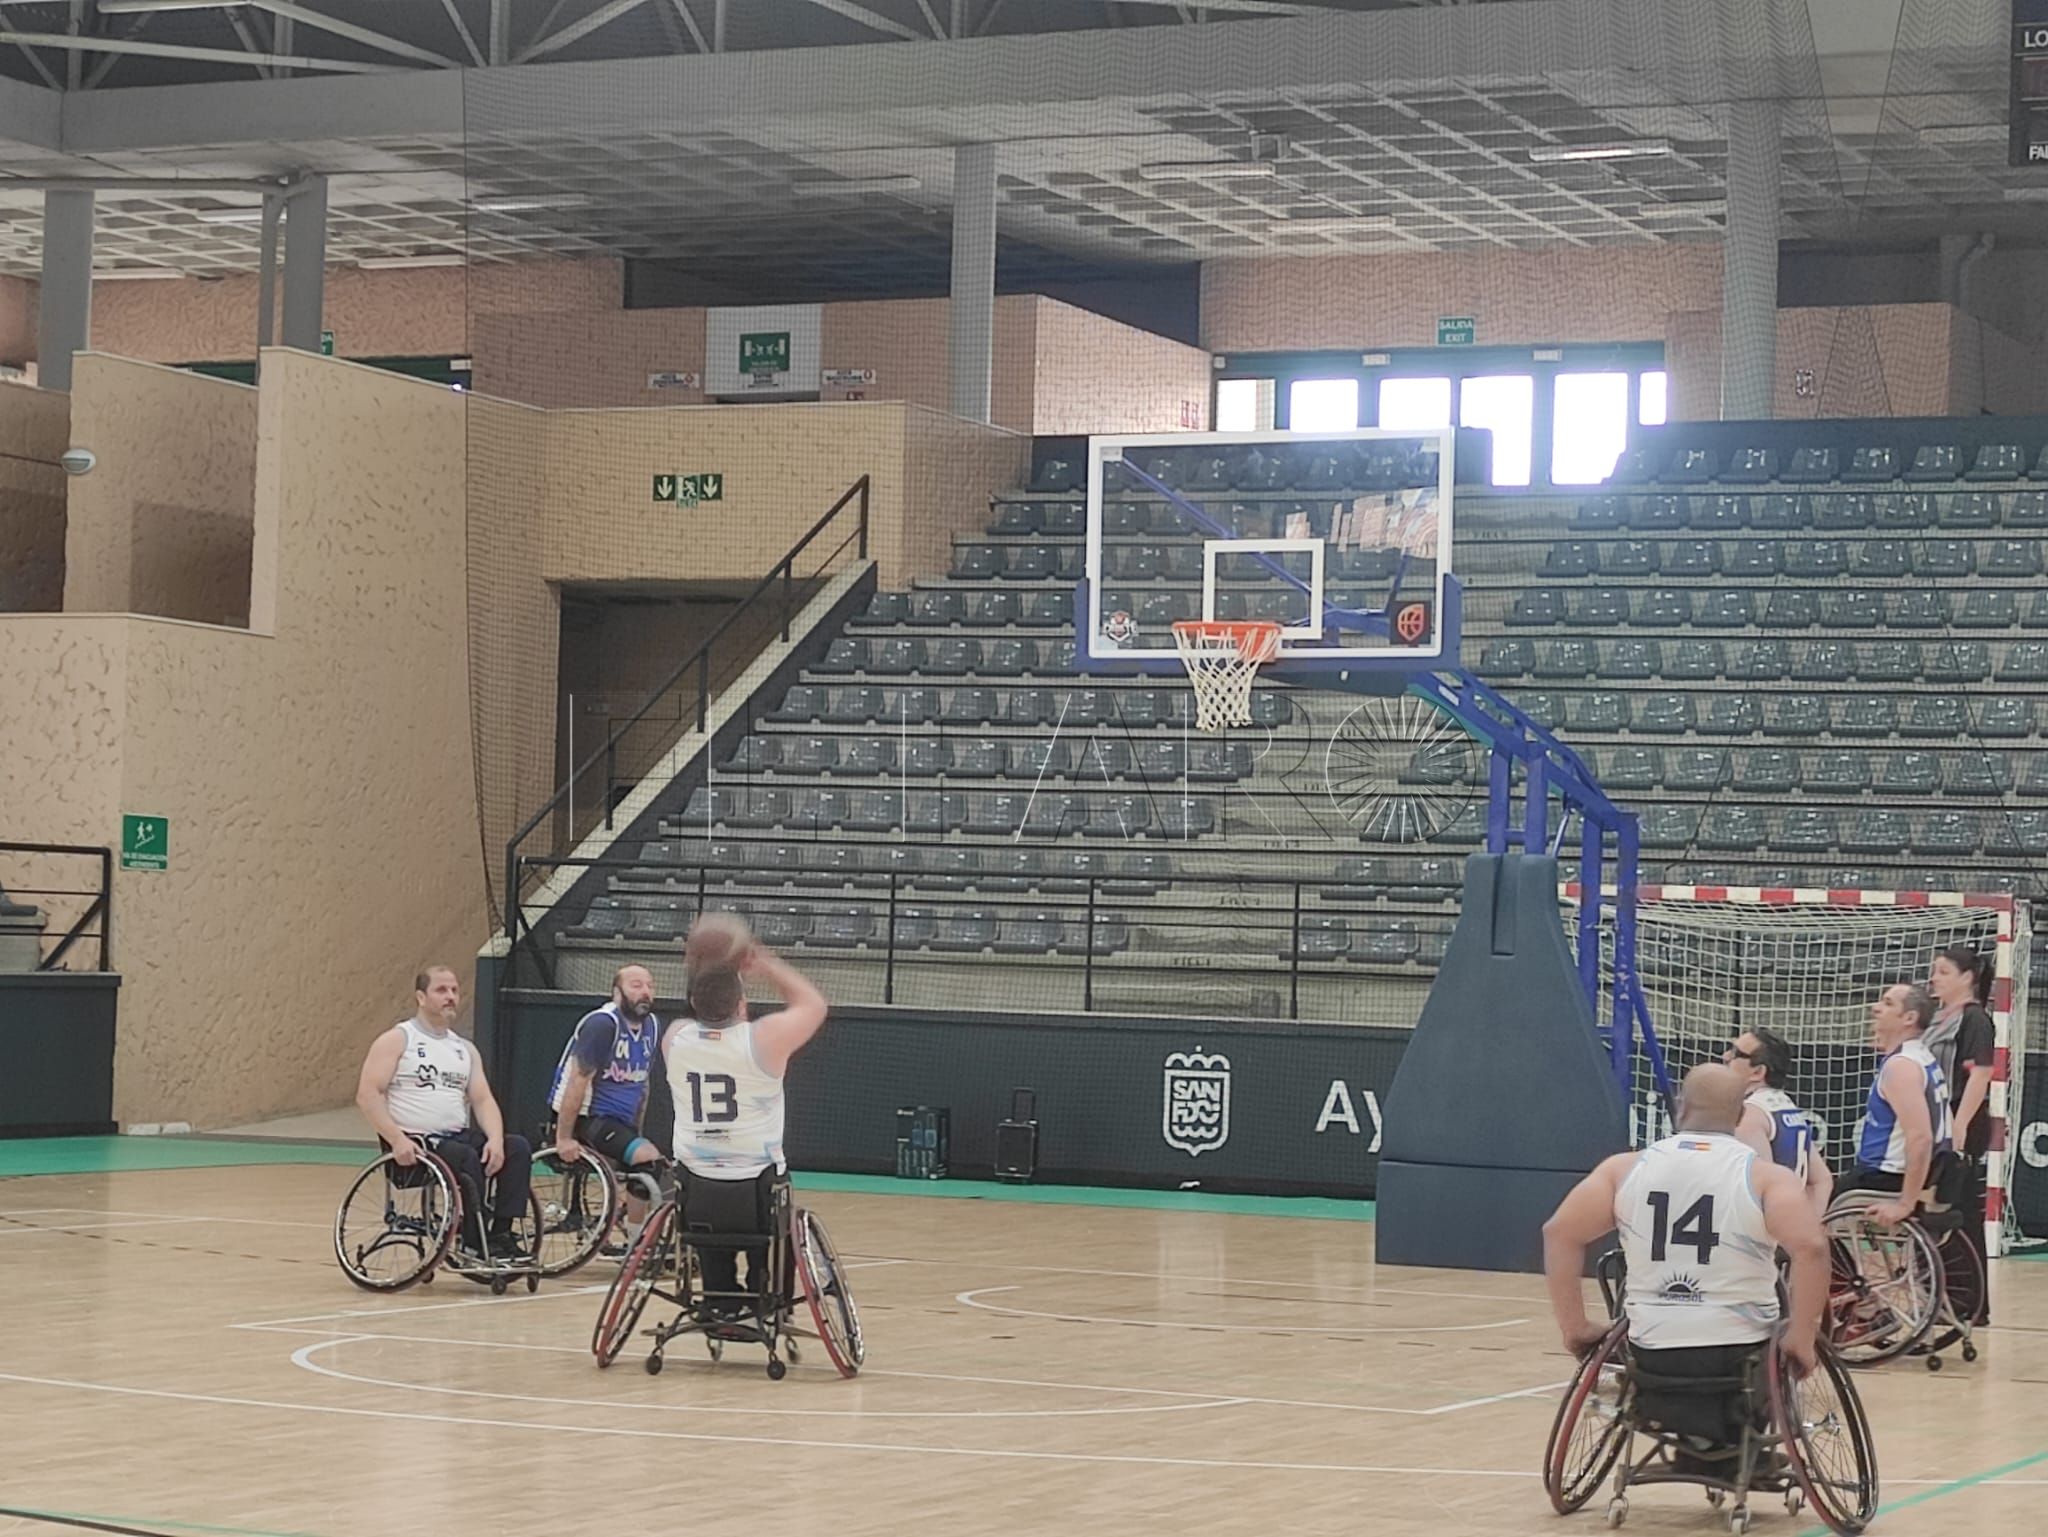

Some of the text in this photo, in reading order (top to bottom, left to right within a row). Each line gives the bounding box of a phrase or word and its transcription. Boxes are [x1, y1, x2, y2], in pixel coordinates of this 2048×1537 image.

[2029, 145, 2048, 161] FA
[1439, 319, 1473, 330] SALIDA
[1445, 333, 1466, 343] EXIT
[686, 1071, 739, 1123] 13
[1172, 1079, 1221, 1102] SAN
[1646, 1190, 1720, 1265] 14
